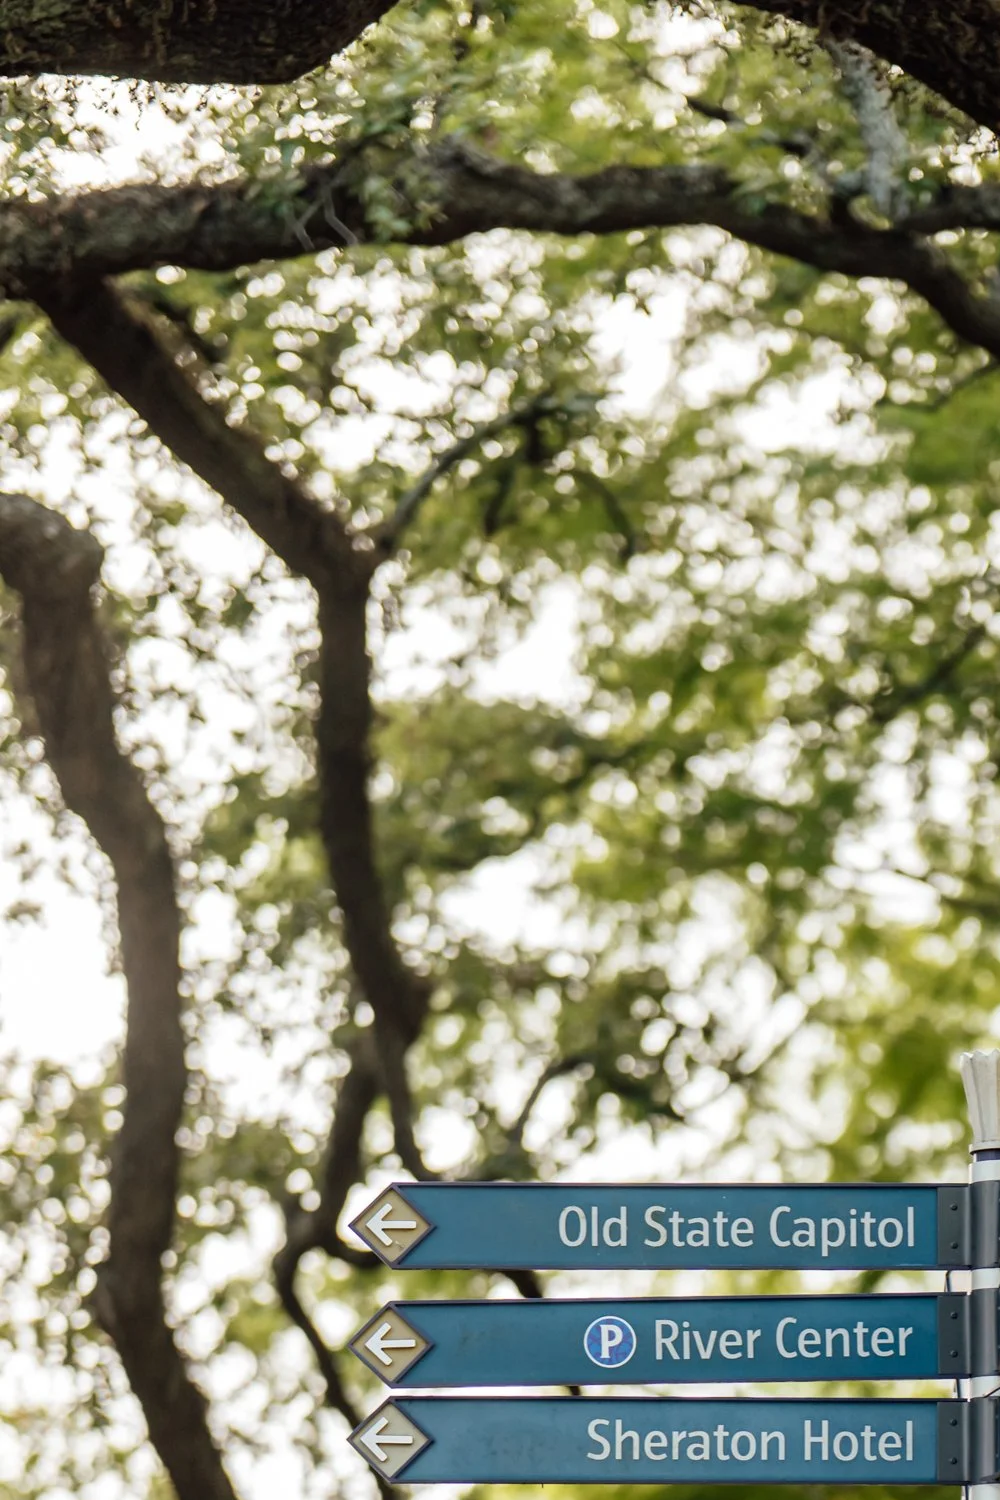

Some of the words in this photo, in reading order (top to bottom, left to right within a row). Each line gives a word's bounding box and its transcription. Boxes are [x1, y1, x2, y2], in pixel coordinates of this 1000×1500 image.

[558, 1205, 628, 1247] Old
[644, 1205, 754, 1248] State
[769, 1205, 915, 1257] Capitol
[599, 1324, 624, 1359] P
[655, 1319, 762, 1361] River
[775, 1316, 913, 1359] Center
[586, 1418, 786, 1461] Sheraton
[804, 1419, 914, 1462] Hotel
